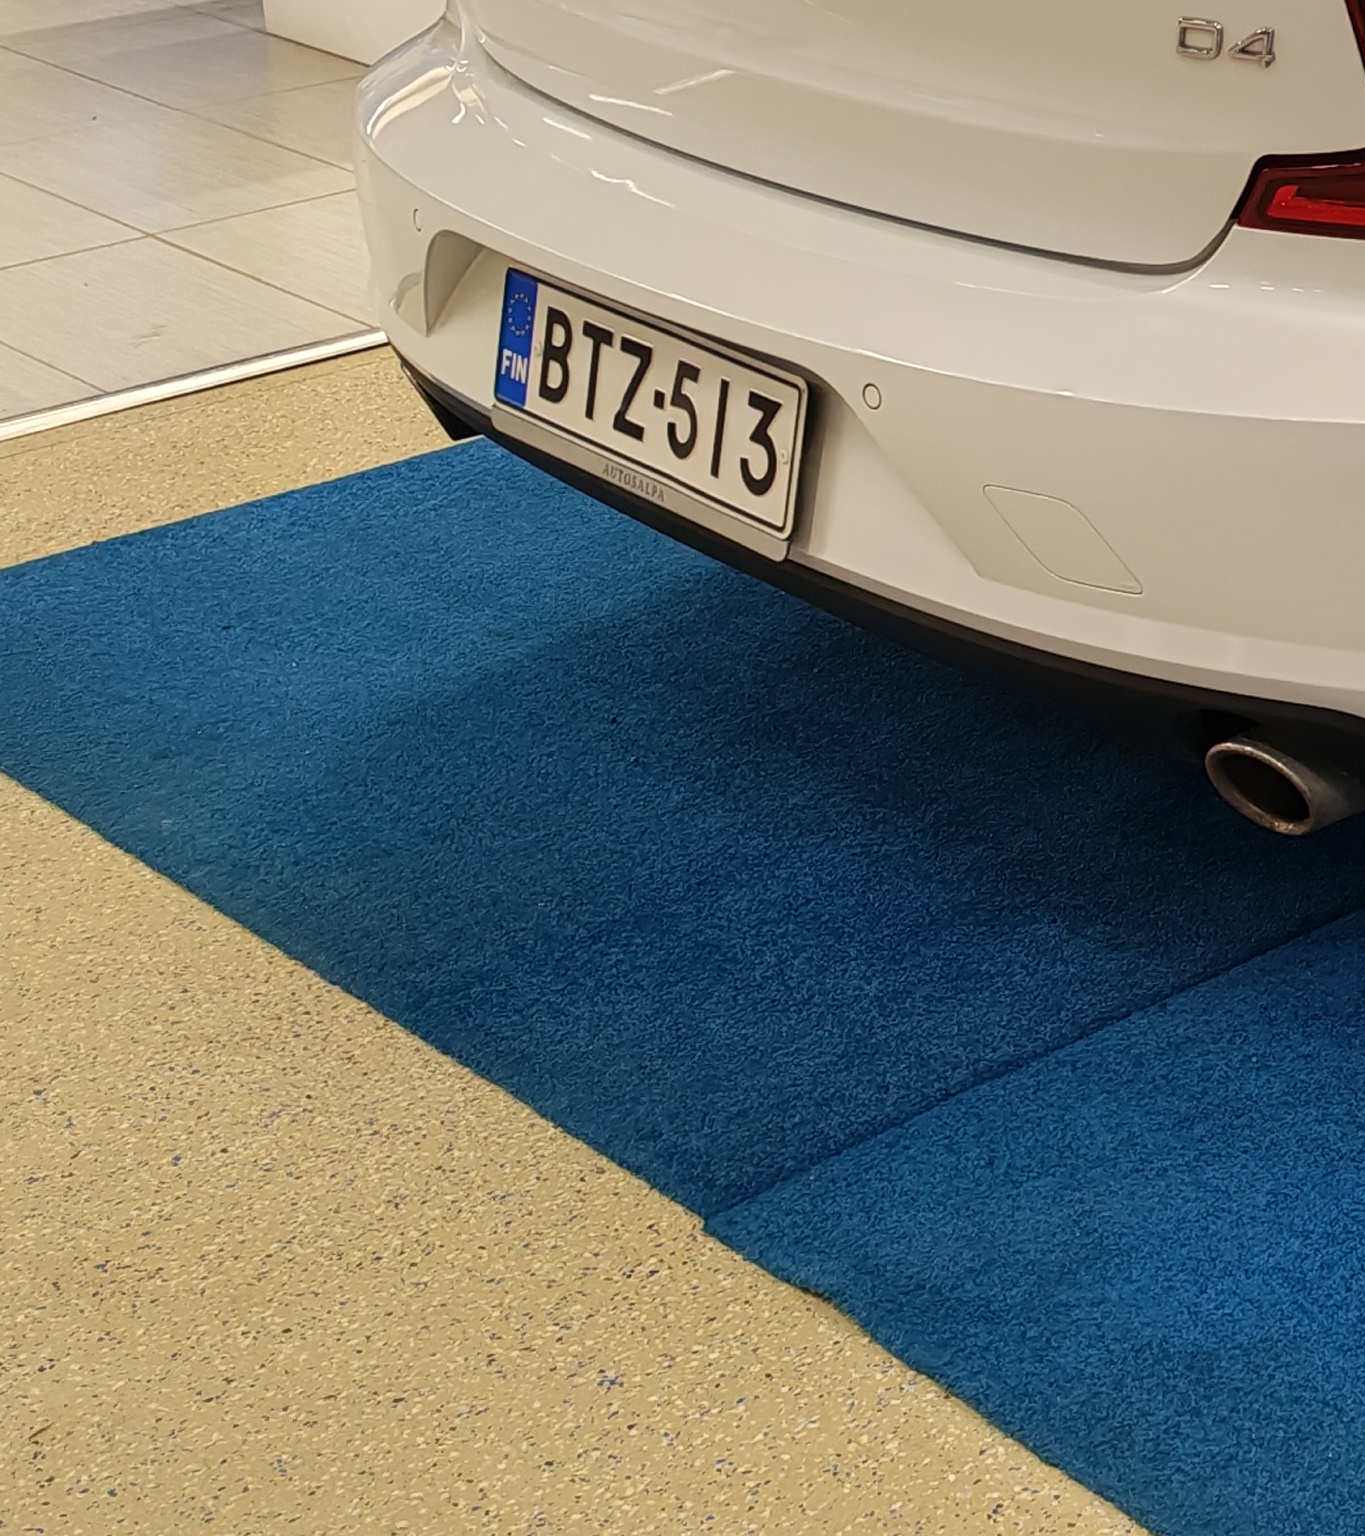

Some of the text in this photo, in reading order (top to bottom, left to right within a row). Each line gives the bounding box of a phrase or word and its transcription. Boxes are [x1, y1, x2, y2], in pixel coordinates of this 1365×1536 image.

[1176, 16, 1276, 68] D4
[501, 349, 528, 384] FIN
[538, 305, 783, 496] BTZ-513
[602, 463, 665, 503] AUTOSALPA
